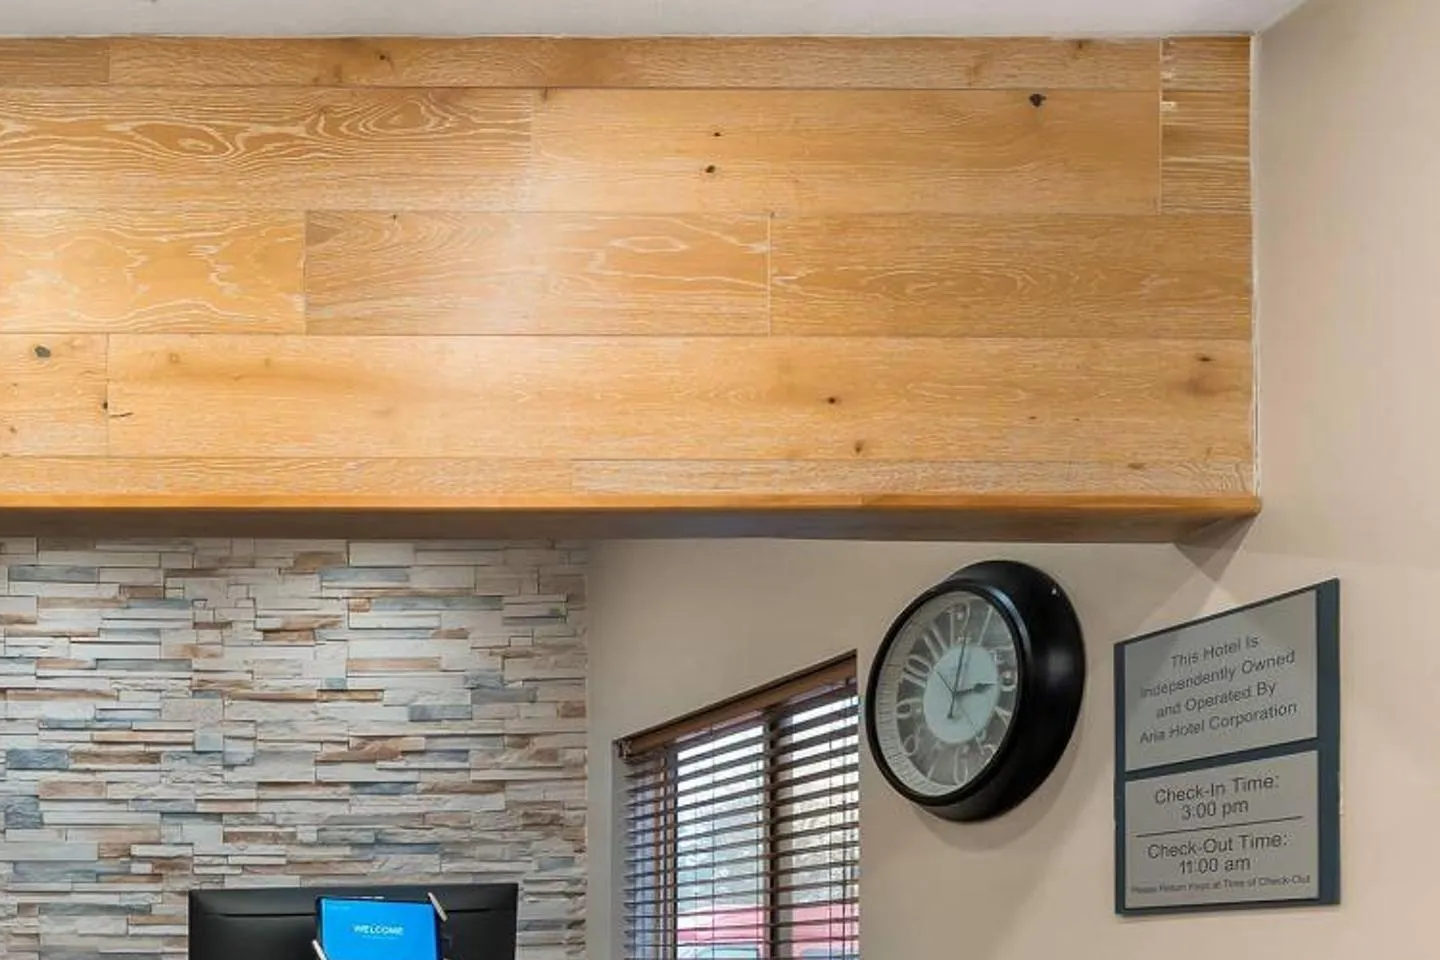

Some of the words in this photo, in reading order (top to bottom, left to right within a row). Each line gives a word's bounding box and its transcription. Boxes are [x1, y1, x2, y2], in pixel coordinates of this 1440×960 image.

[1171, 654, 1199, 668] This
[1203, 639, 1242, 661] Hotel
[1246, 636, 1260, 648] Is
[1140, 666, 1237, 698] Independently
[1241, 650, 1296, 674] Owned
[1156, 702, 1182, 719] and
[1185, 686, 1252, 712] Operated
[1256, 681, 1277, 698] By
[1169, 719, 1205, 739] Hotel
[1209, 703, 1298, 731] Corporation
[1155, 783, 1226, 804] Check-In
[1232, 775, 1280, 794] Time:
[1181, 802, 1216, 820] 3:00
[1221, 800, 1249, 818] pm
[1148, 837, 1233, 859] Check-Out
[1238, 834, 1288, 850] Time:
[1179, 858, 1219, 875] 11:00
[1224, 858, 1251, 872] am
[353, 924, 405, 936] WELCOME
